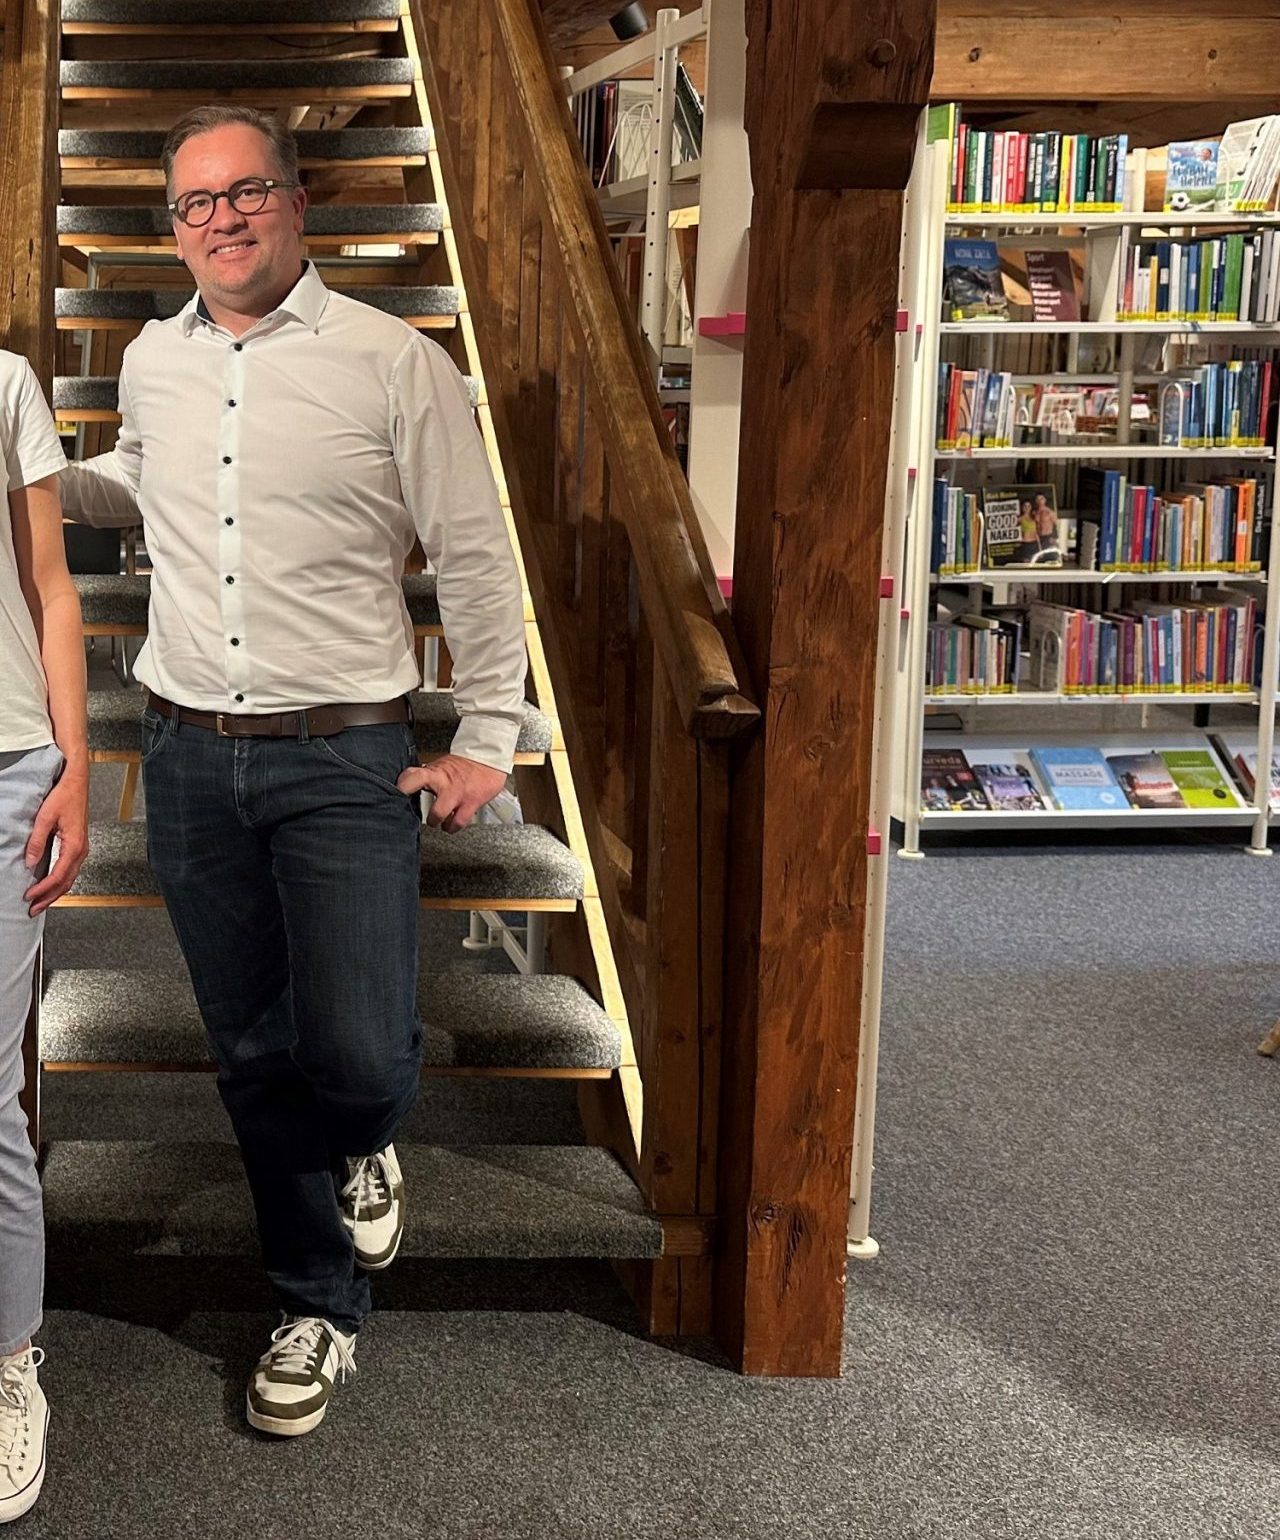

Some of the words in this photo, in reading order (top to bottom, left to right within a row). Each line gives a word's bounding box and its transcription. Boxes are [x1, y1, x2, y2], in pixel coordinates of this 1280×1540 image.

[987, 503, 1017, 512] LOOKING
[988, 514, 1018, 529] GOOD
[990, 529, 1020, 541] NAKED
[1055, 770, 1105, 779] MASSAGE
